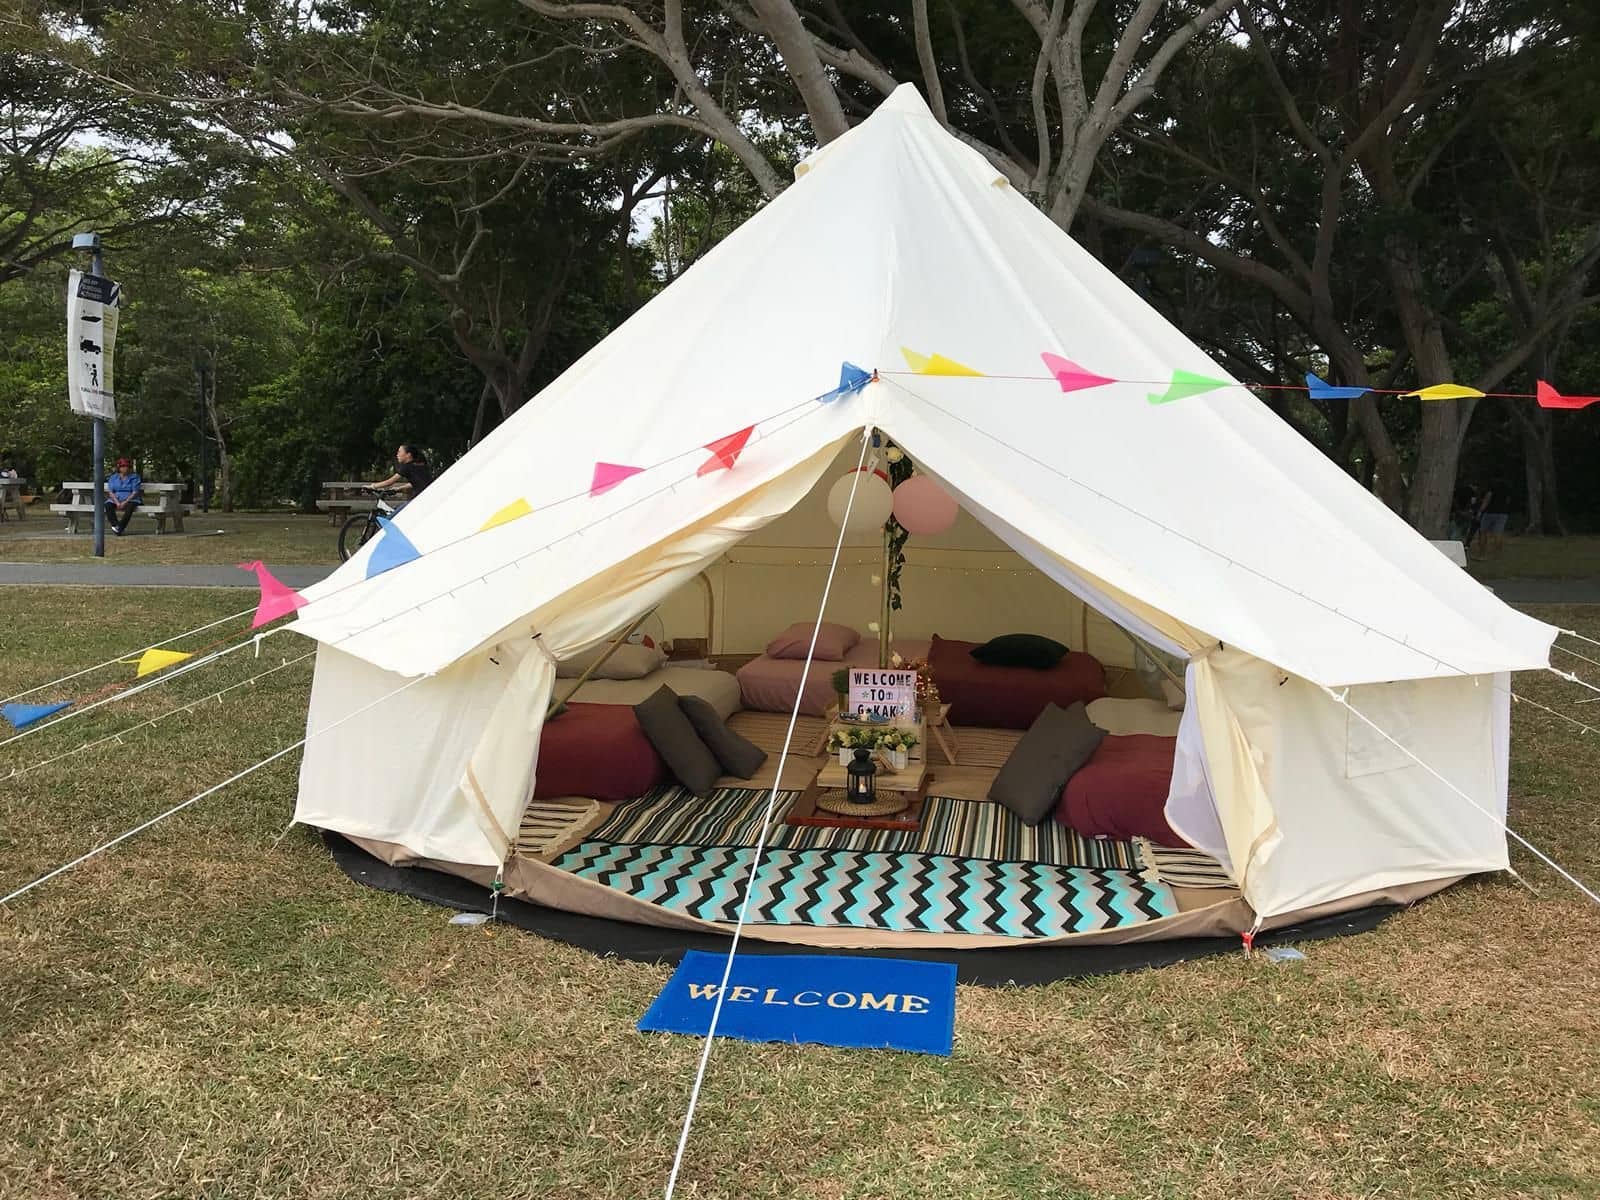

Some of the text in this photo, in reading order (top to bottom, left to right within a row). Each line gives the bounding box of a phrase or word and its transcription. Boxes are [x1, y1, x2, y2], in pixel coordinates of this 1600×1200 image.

[854, 672, 912, 686] WELCOME
[870, 689, 885, 701] TO
[688, 983, 930, 1014] WELCOME
